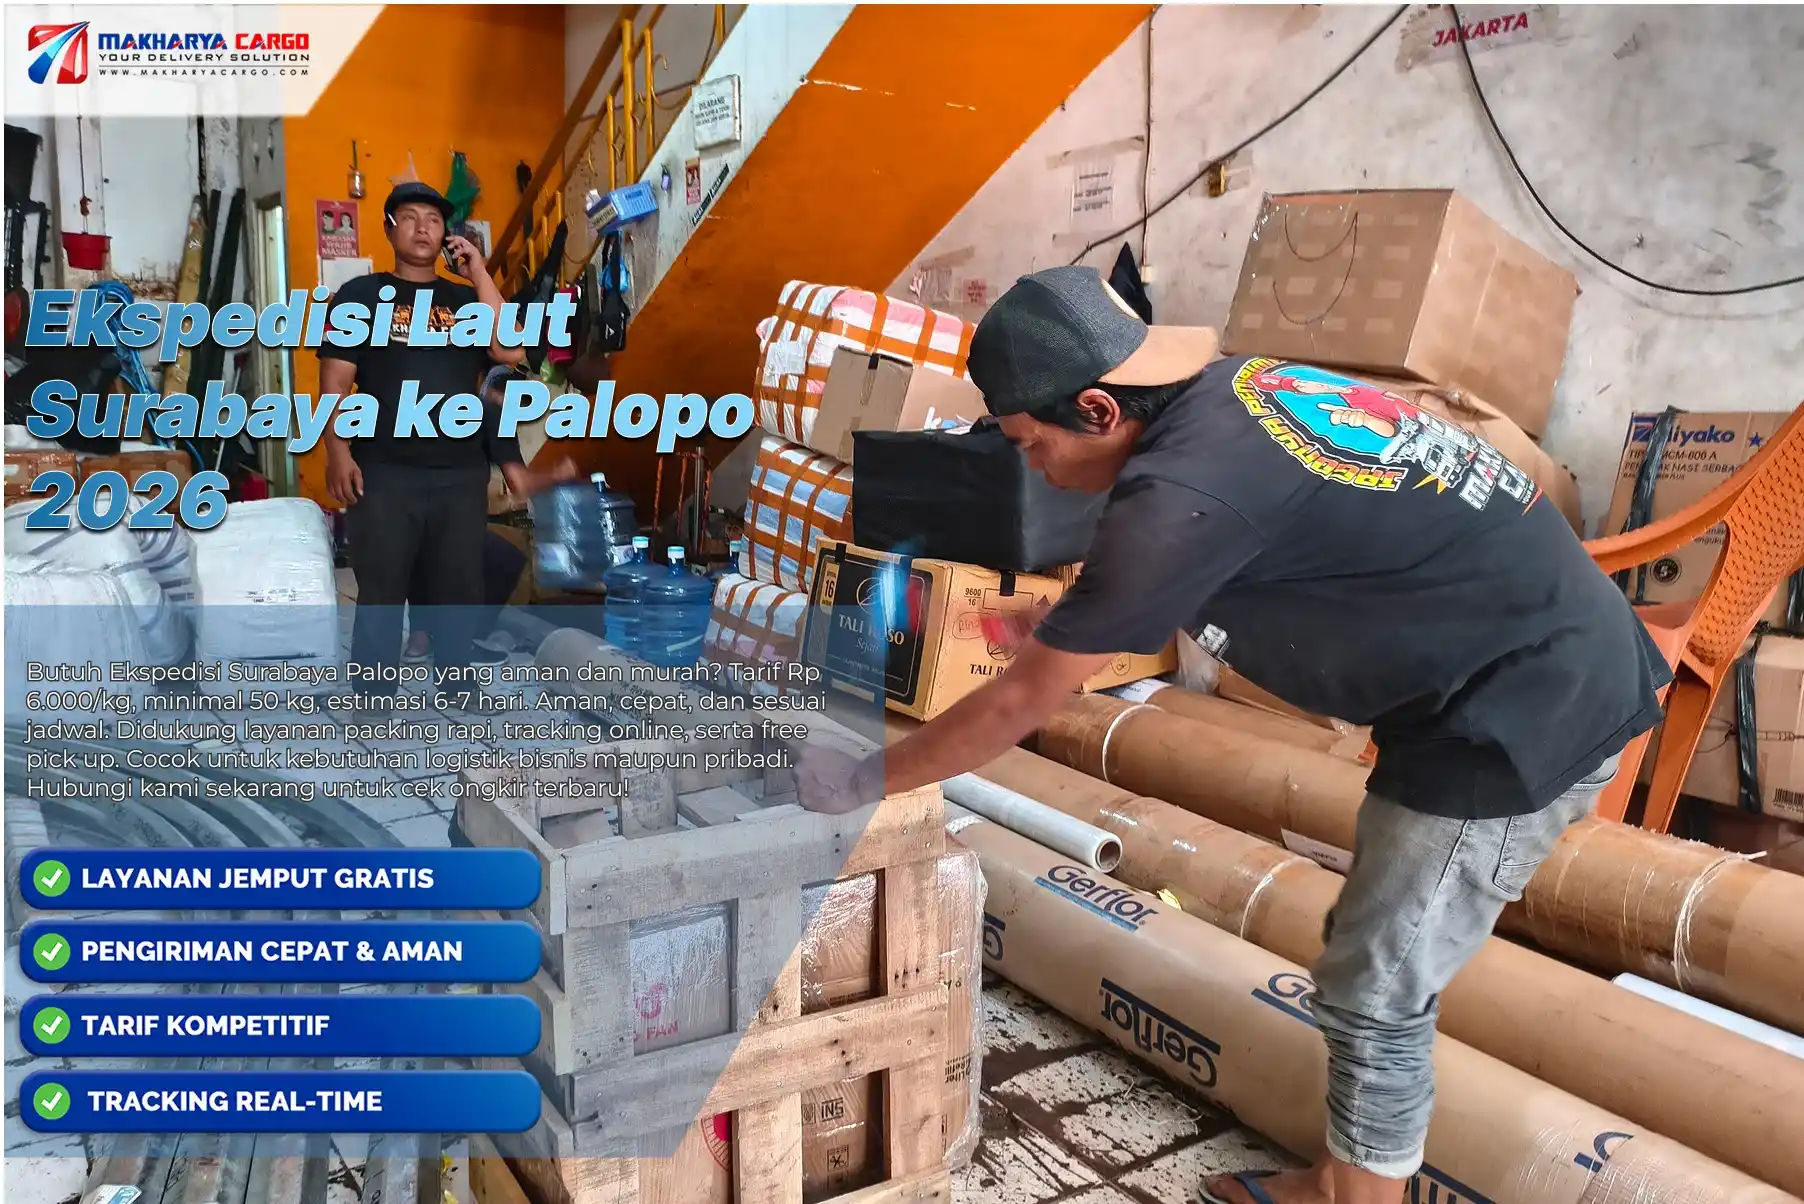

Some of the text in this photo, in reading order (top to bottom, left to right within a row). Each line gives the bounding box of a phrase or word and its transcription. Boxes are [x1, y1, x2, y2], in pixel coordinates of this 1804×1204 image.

[1432, 12, 1528, 47] JAKARTA
[1666, 424, 1735, 447] iyako
[1259, 414, 1408, 491] JAGONYA
[824, 579, 836, 598] 16
[965, 587, 982, 597] 9600
[968, 598, 977, 607] 16
[838, 613, 905, 646] TALI RSO
[969, 663, 993, 676] TALI
[1047, 865, 1159, 925] Gerflor
[1100, 990, 1218, 1088] Gerflor
